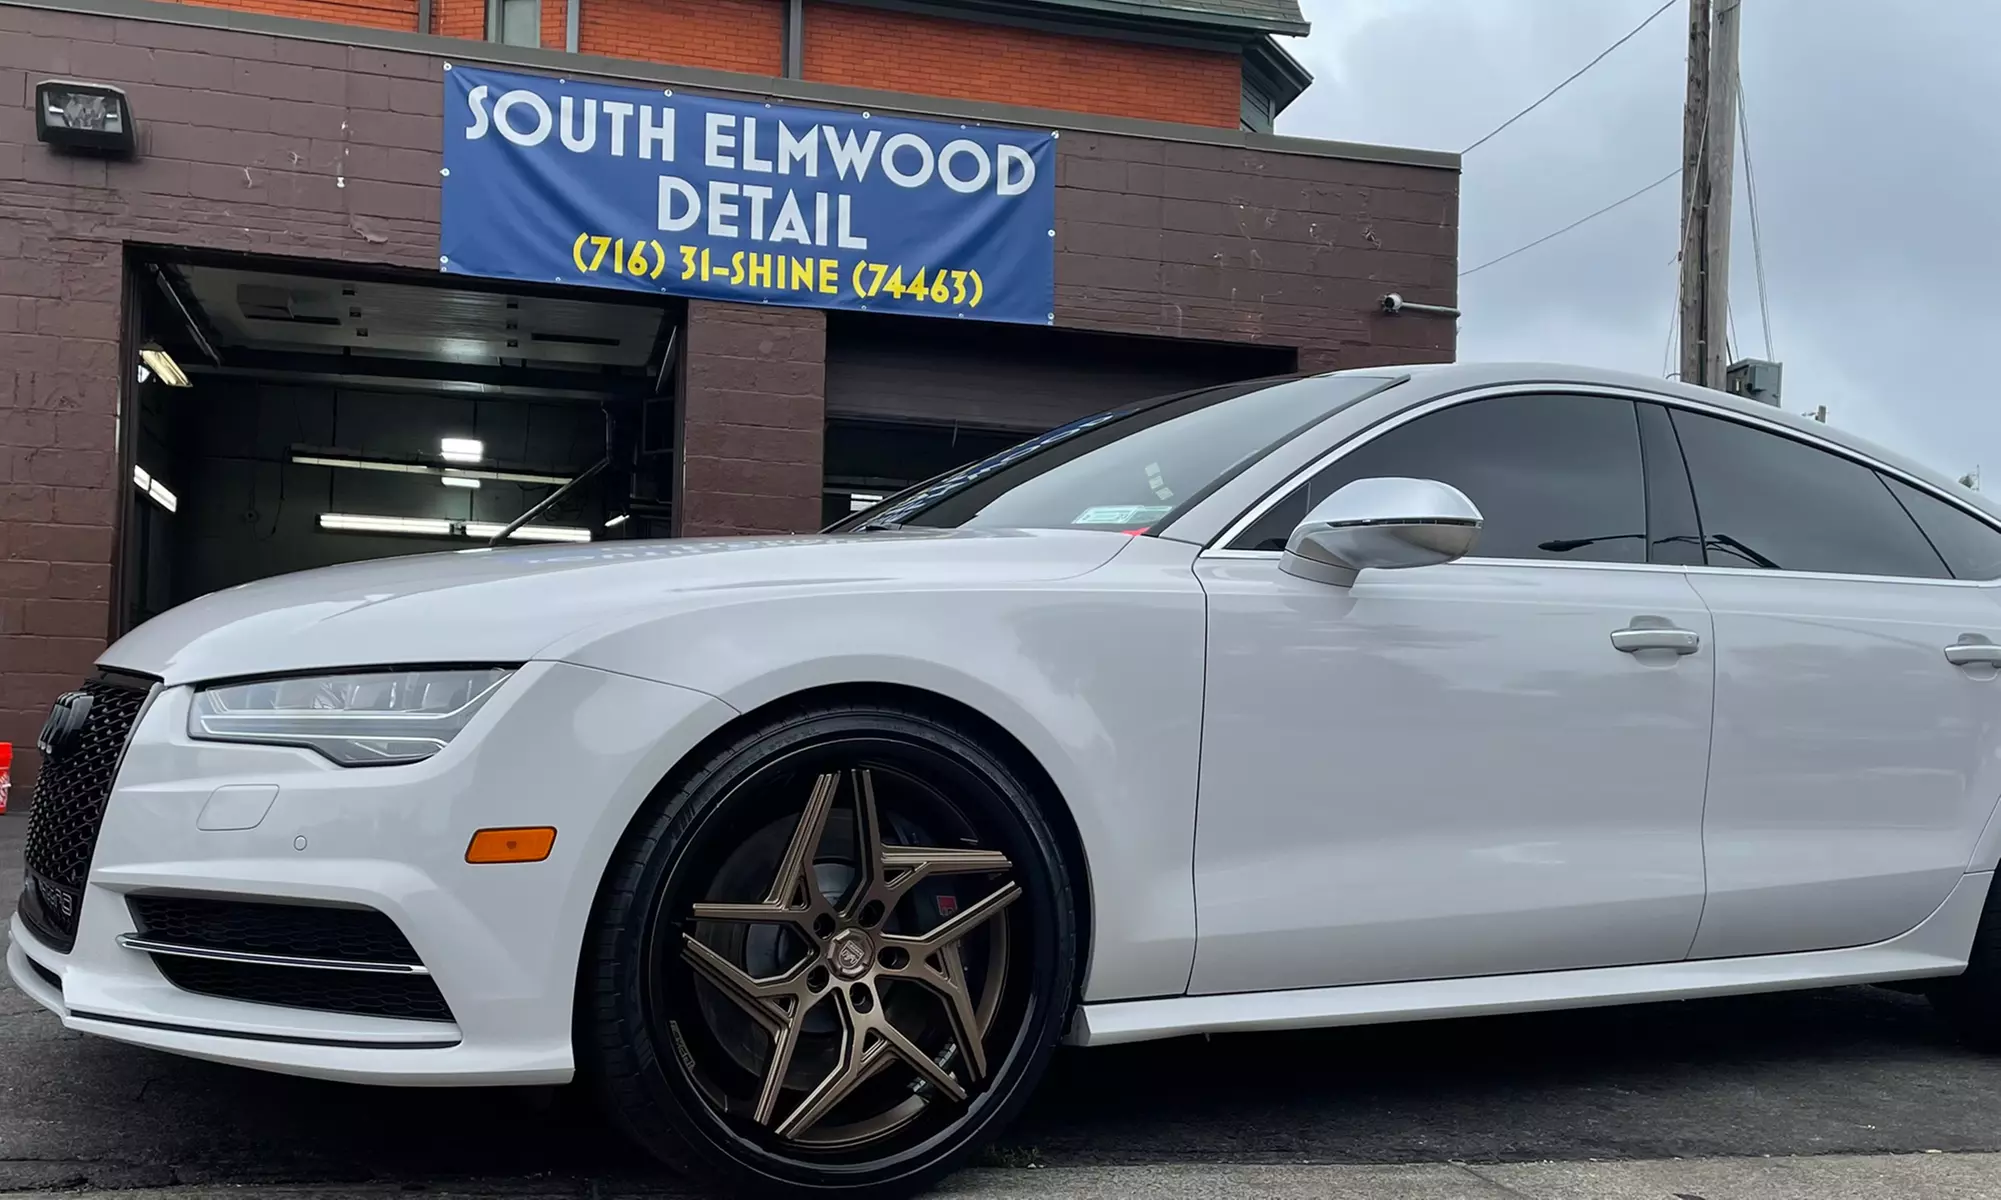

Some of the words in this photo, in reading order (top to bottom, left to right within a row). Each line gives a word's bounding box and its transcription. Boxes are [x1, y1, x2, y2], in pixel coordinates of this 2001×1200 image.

[465, 85, 676, 163] SOUTH
[705, 112, 1037, 196] ELMWOOD
[658, 175, 867, 250] DETAIL
[572, 232, 666, 280] (716)
[680, 245, 839, 295] 31-SHINE
[852, 259, 984, 308] (74463)
